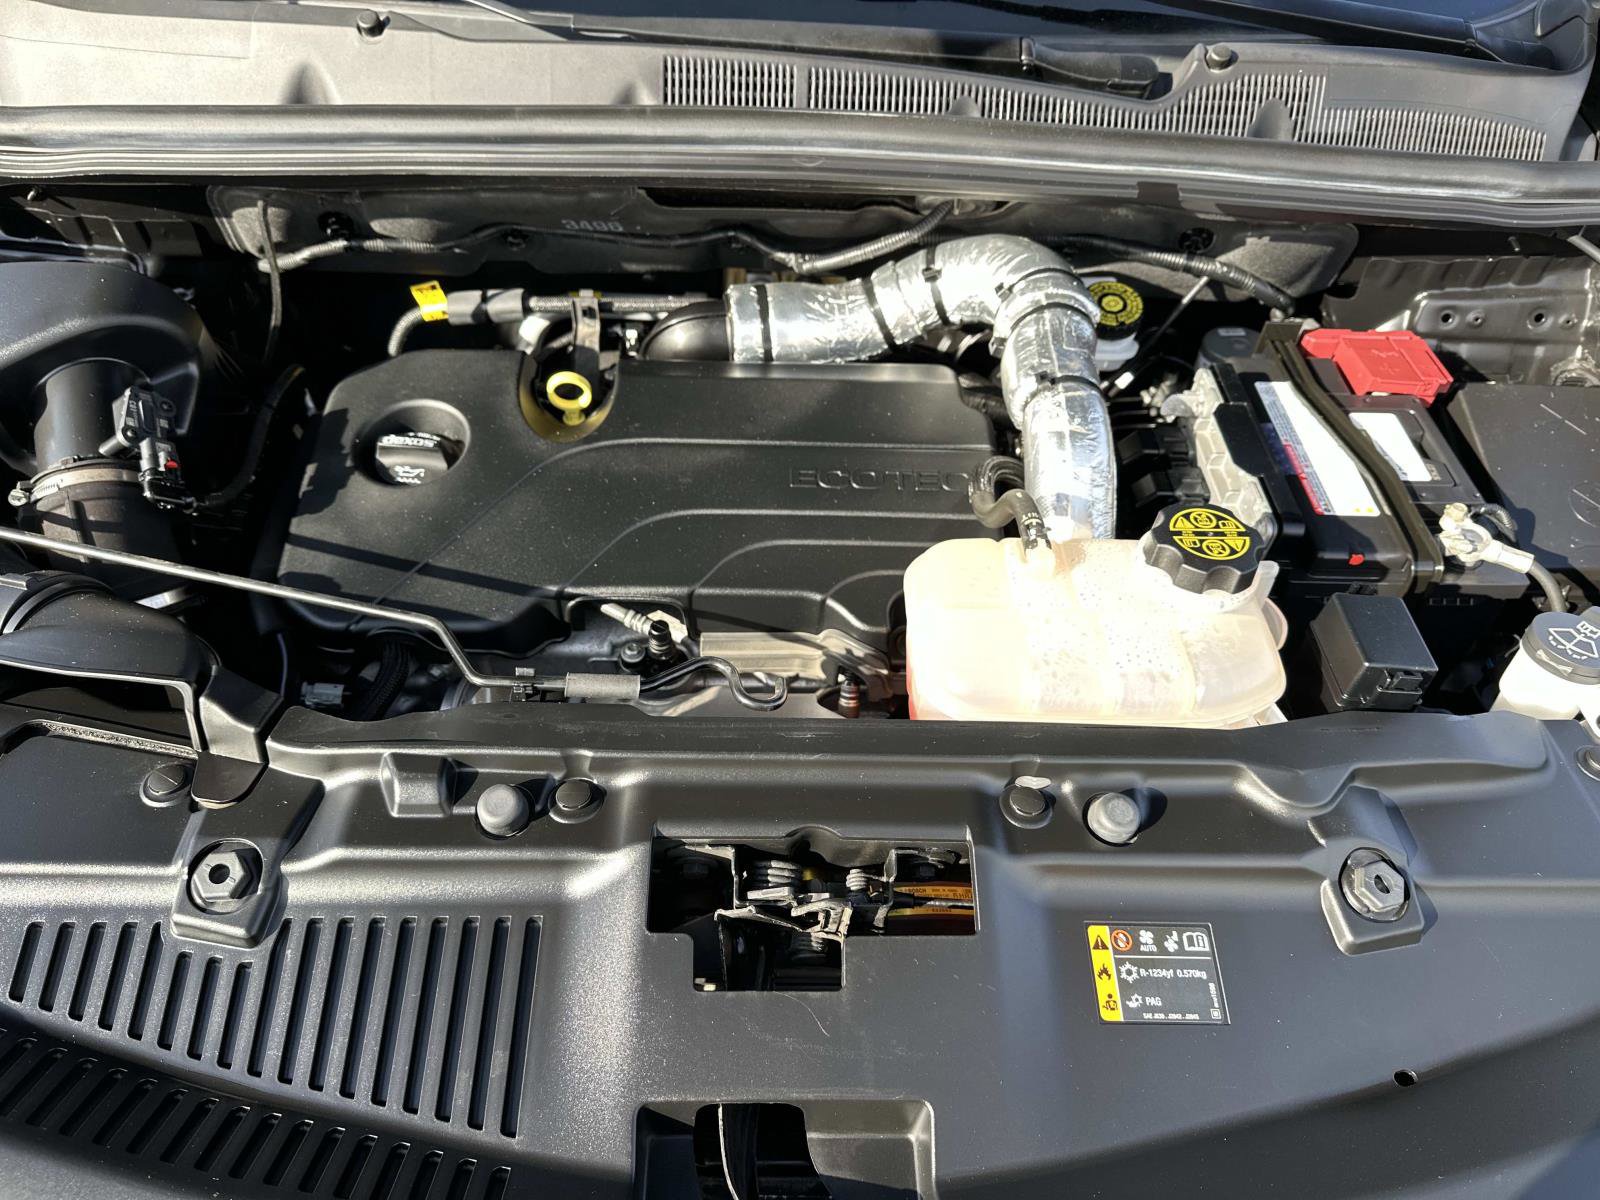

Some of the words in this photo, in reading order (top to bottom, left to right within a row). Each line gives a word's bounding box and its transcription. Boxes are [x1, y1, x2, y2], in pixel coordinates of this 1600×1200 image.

[790, 470, 970, 492] ECOTEC
[1140, 944, 1157, 952] AUTO
[1140, 968, 1174, 979] R-1234yf
[1145, 997, 1162, 1006] PAG
